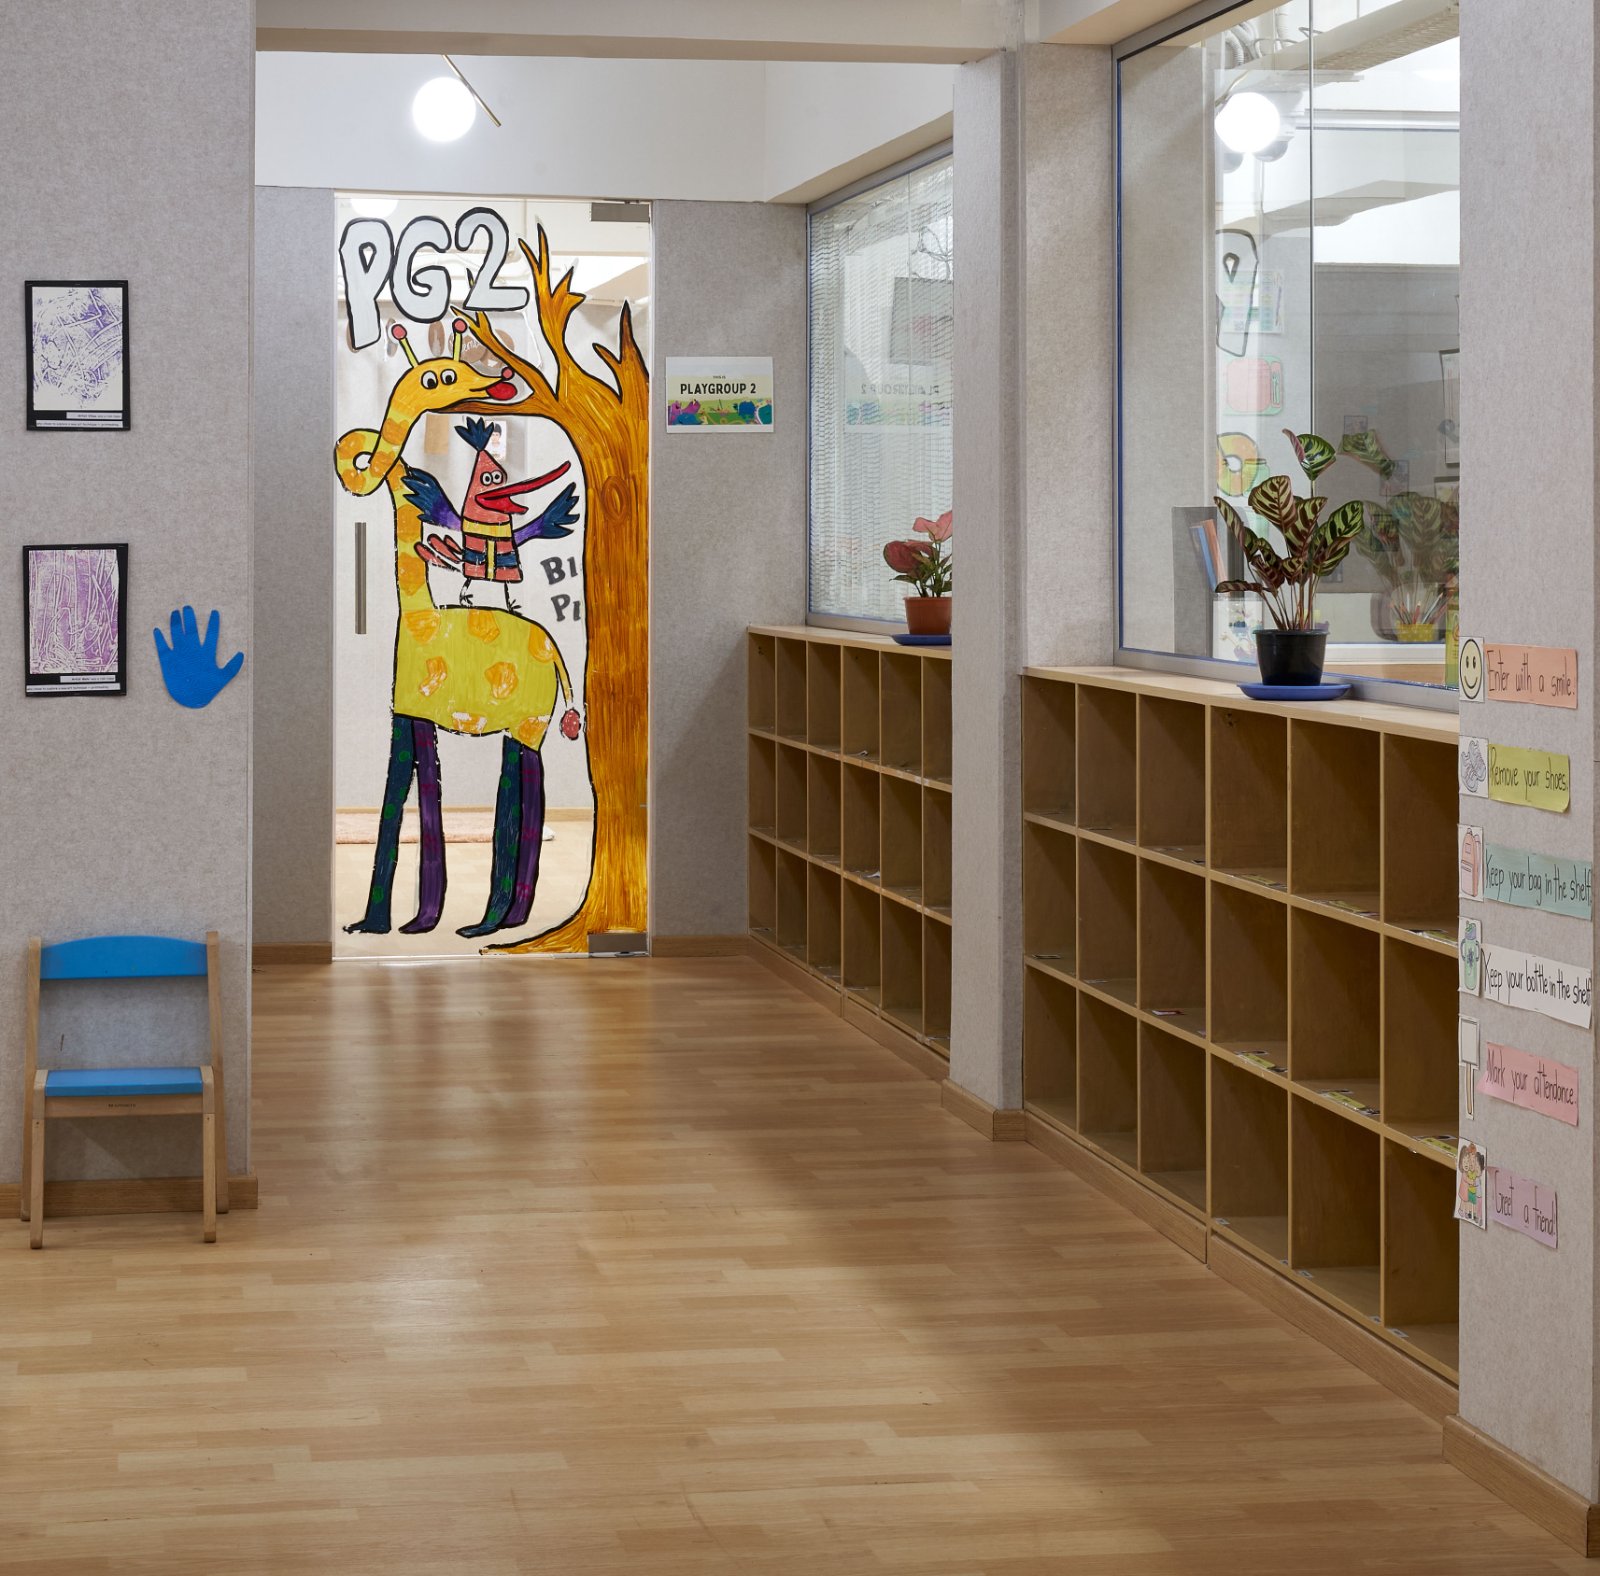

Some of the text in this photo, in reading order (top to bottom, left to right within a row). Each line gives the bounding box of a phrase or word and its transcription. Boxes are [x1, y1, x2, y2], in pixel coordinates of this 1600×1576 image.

[339, 206, 530, 351] PG2
[680, 383, 756, 395] PLAYGROUP 2
[1487, 649, 1575, 697] Enter with a smile.
[1490, 746, 1568, 800] Remove your shoes.
[1486, 848, 1504, 900] Keep
[1508, 870, 1526, 902] your
[1528, 855, 1542, 906] bag
[1545, 873, 1552, 895] in
[1553, 864, 1567, 902] the
[1481, 948, 1502, 1000] Keep
[1506, 970, 1524, 1004] your
[1526, 960, 1548, 994] bottle
[1548, 976, 1556, 998] in
[1557, 968, 1571, 1000] the
[1486, 1048, 1577, 1105] Mark your attendance.
[1495, 1170, 1514, 1217] Greet
[1524, 1205, 1529, 1224] a
